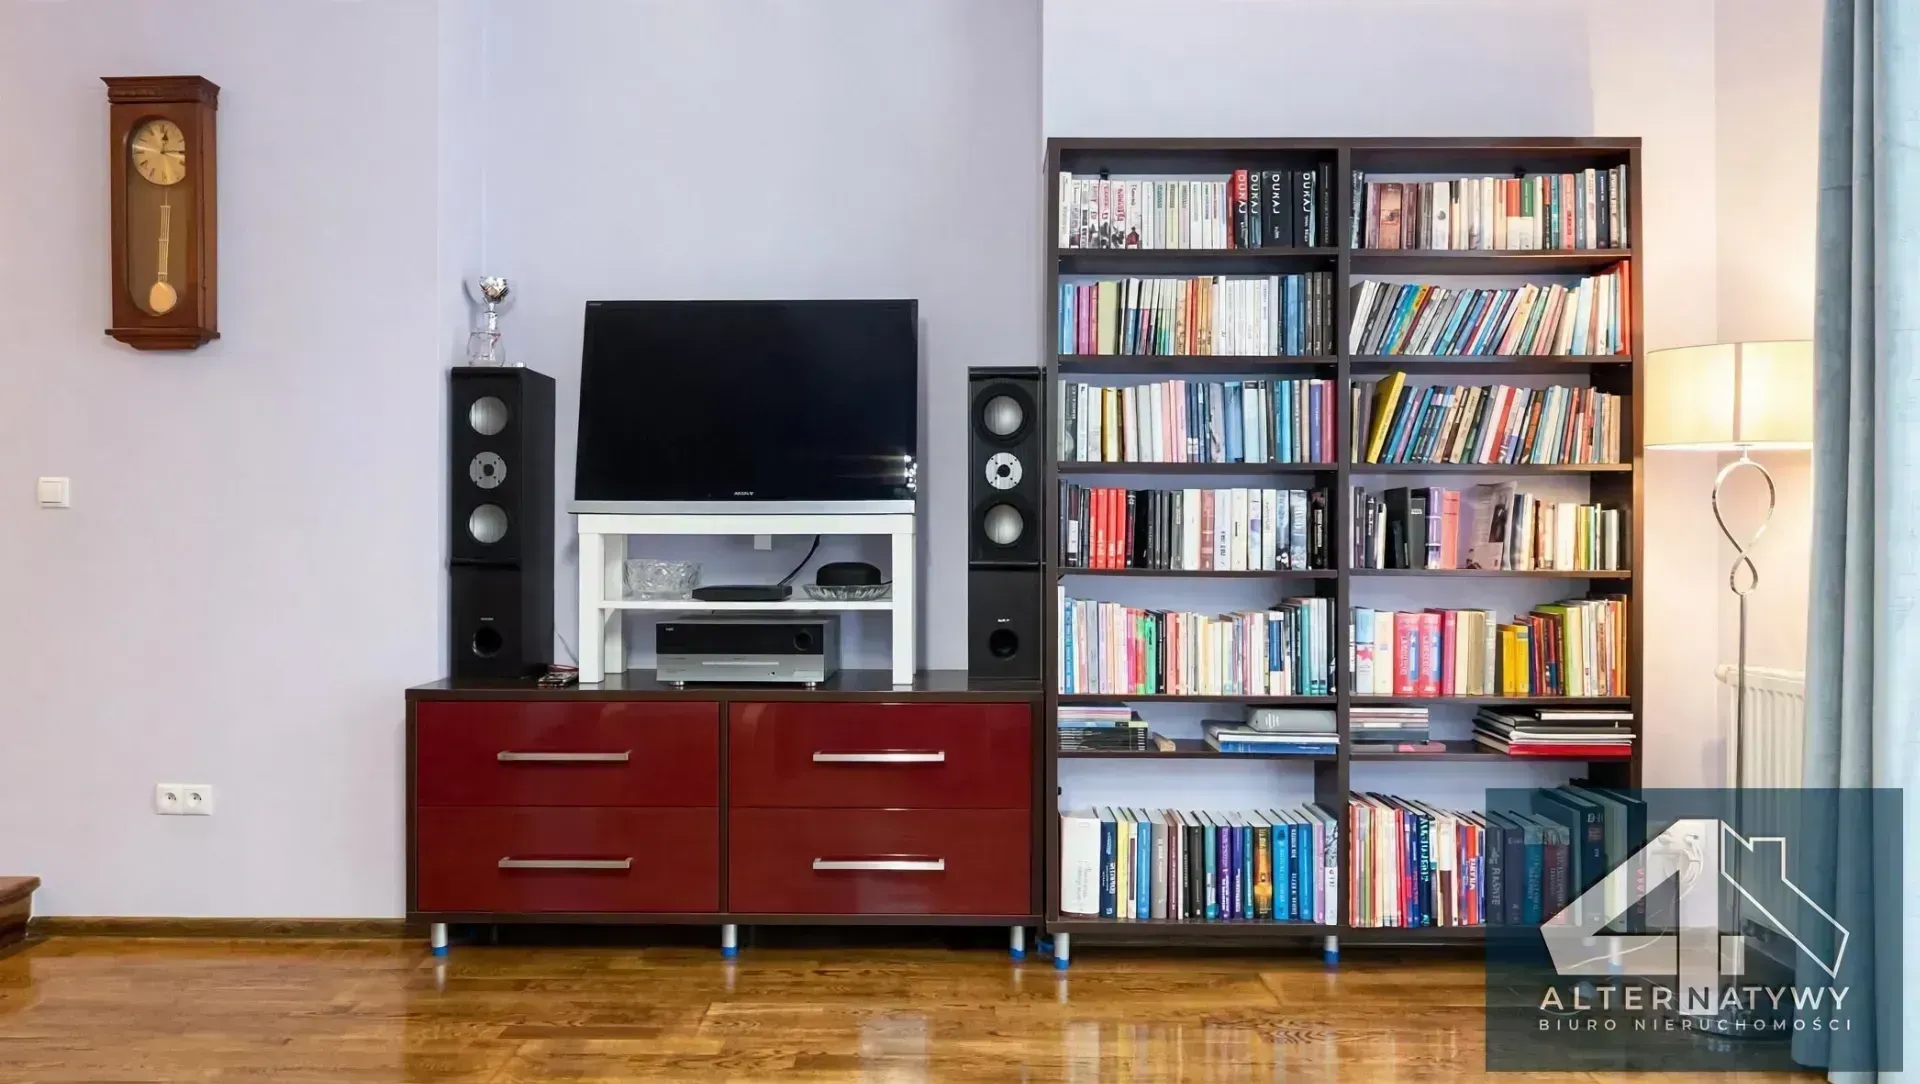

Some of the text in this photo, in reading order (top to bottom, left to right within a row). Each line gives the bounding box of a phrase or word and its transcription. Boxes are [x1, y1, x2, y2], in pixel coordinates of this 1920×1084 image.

[1238, 173, 1247, 214] DUKAJ
[1250, 174, 1259, 214] DUKAJ
[1271, 173, 1280, 214] DUKAJ
[1302, 172, 1311, 213] DUKAJ
